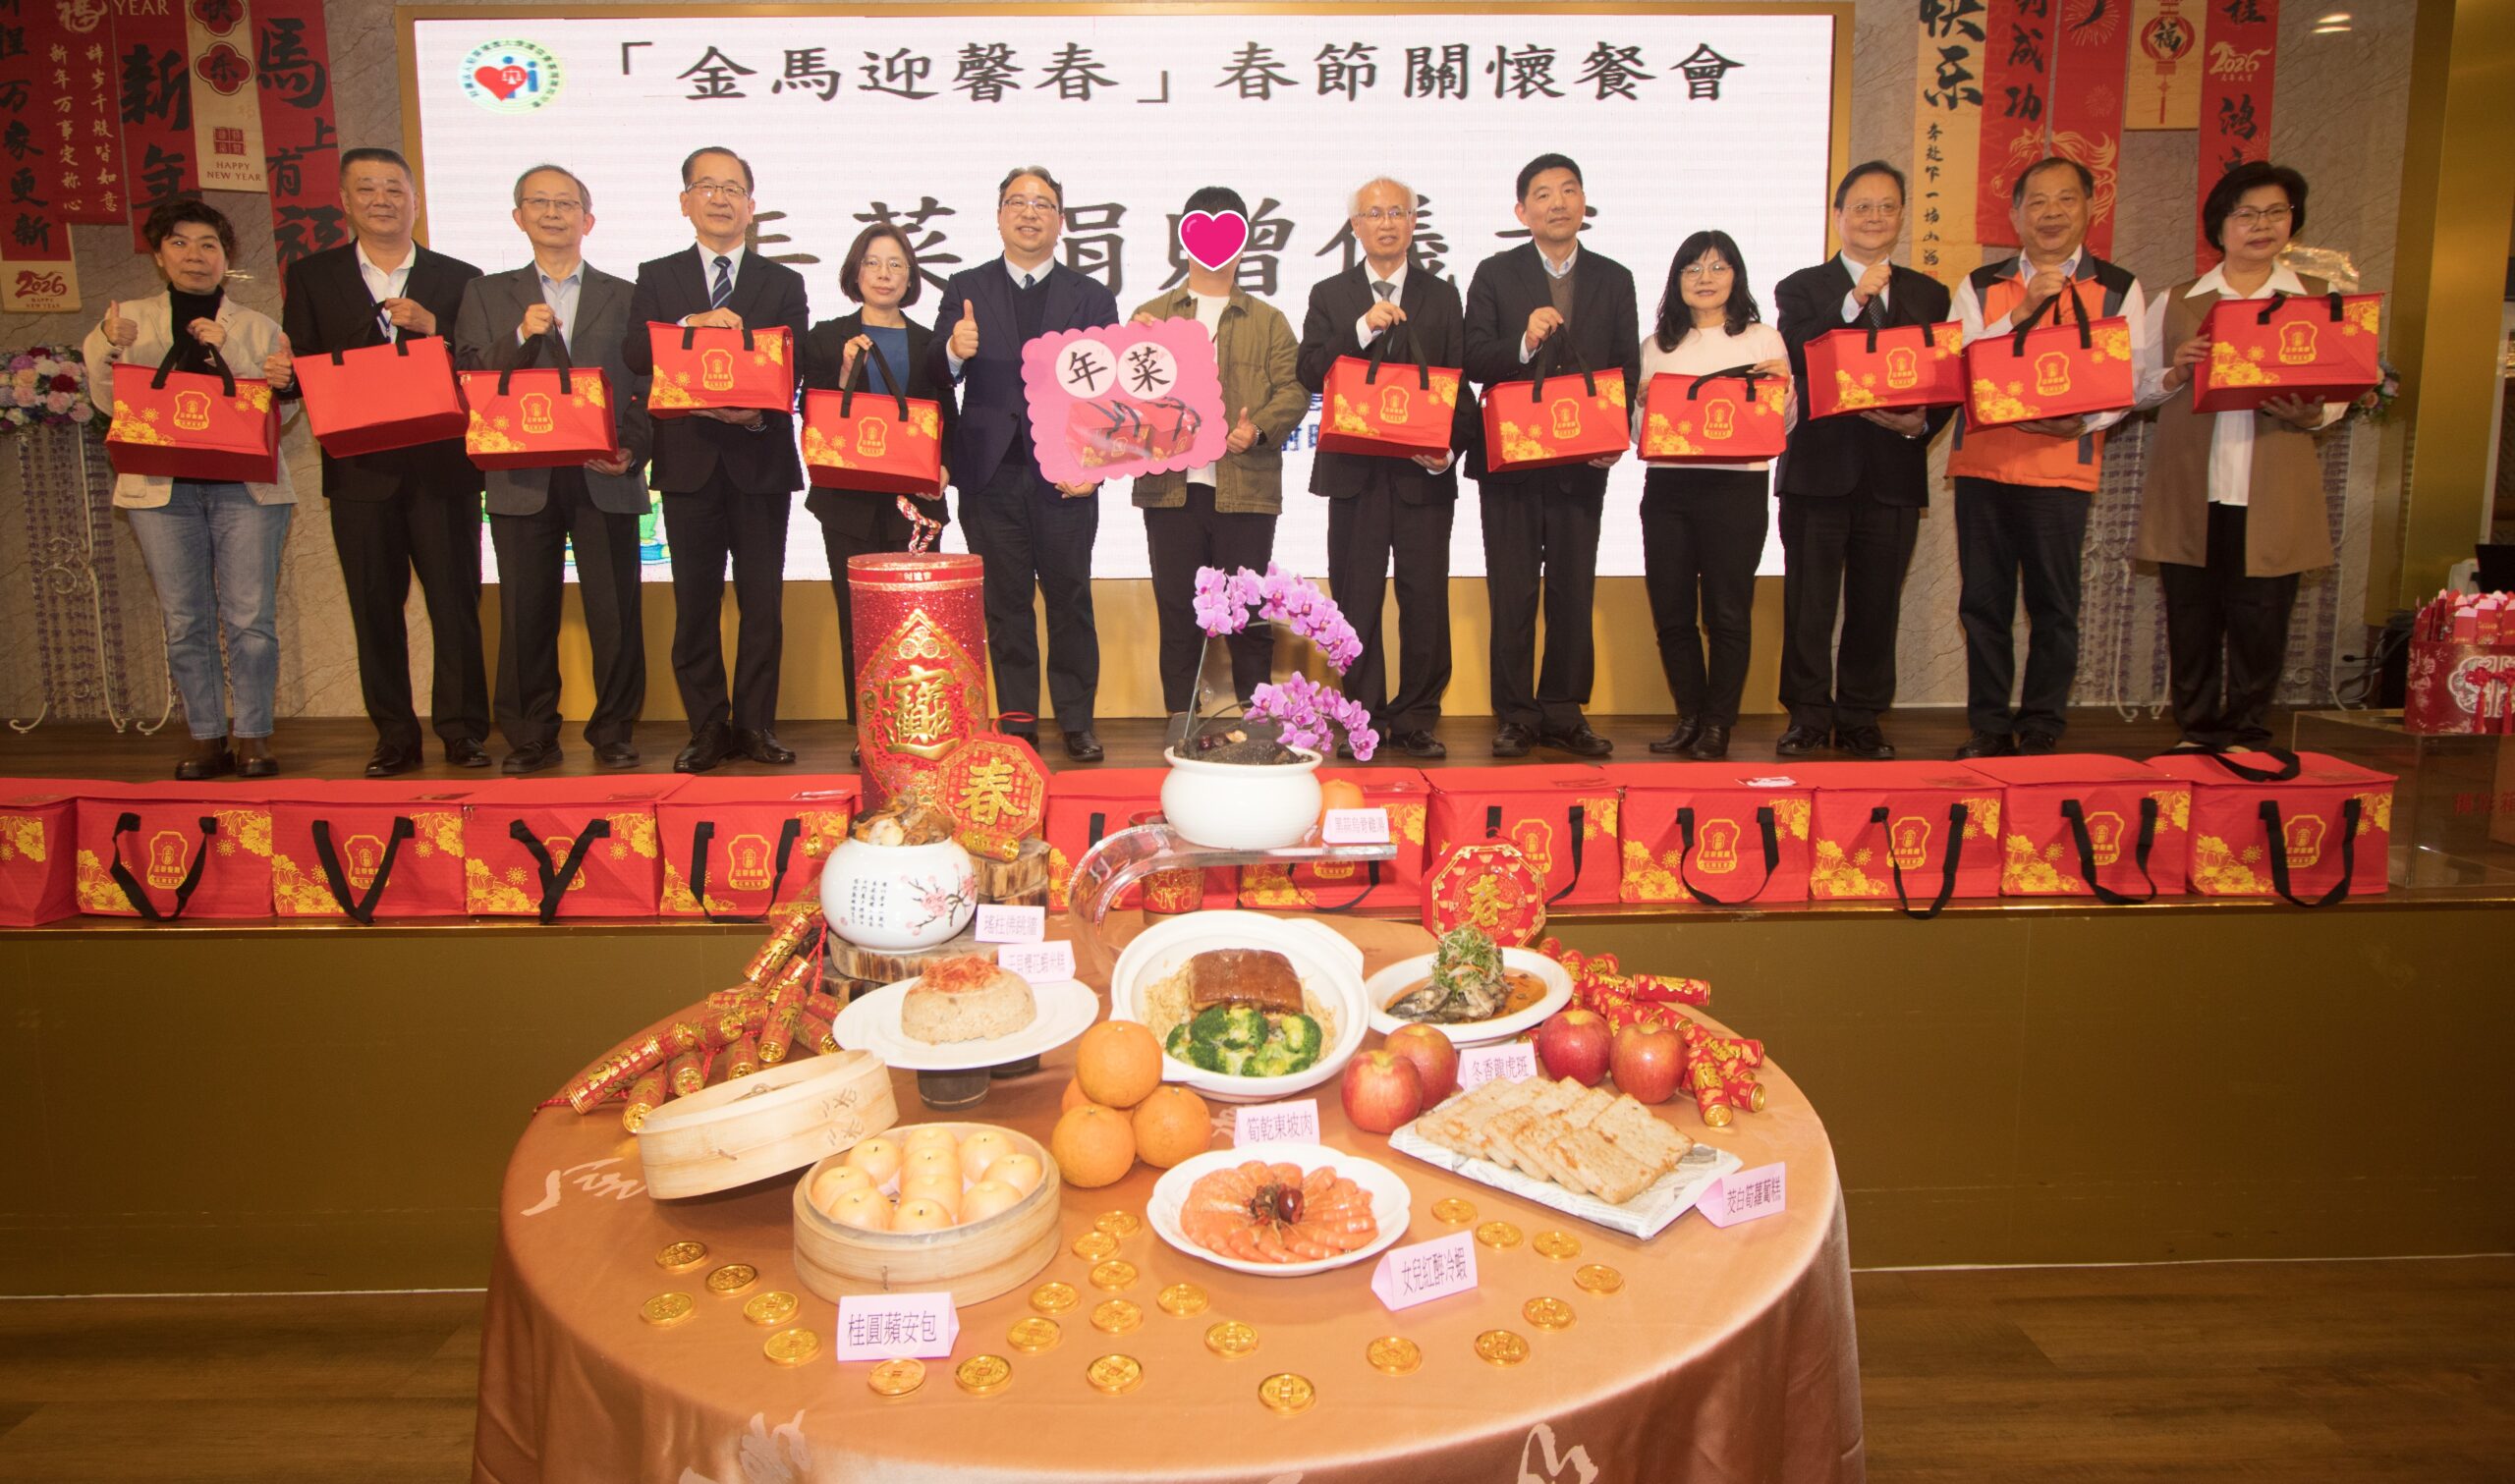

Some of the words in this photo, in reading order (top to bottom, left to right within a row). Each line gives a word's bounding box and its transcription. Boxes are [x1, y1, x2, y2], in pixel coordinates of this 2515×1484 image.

[113, 0, 170, 16] YEAR
[2209, 41, 2273, 75] 2026
[206, 171, 234, 181] NEW
[235, 172, 262, 183] YEAR
[216, 160, 251, 172] HAPPY
[15, 270, 68, 299] 2026
[1067, 346, 1171, 393] 年菜
[954, 756, 1024, 826] 春
[1466, 873, 1514, 927] 春
[1247, 1111, 1313, 1142] 筍乾東坡肉
[1401, 1246, 1467, 1296] 女兒紅醉冷蝦
[848, 1310, 937, 1347] 桂圓蘋安包
